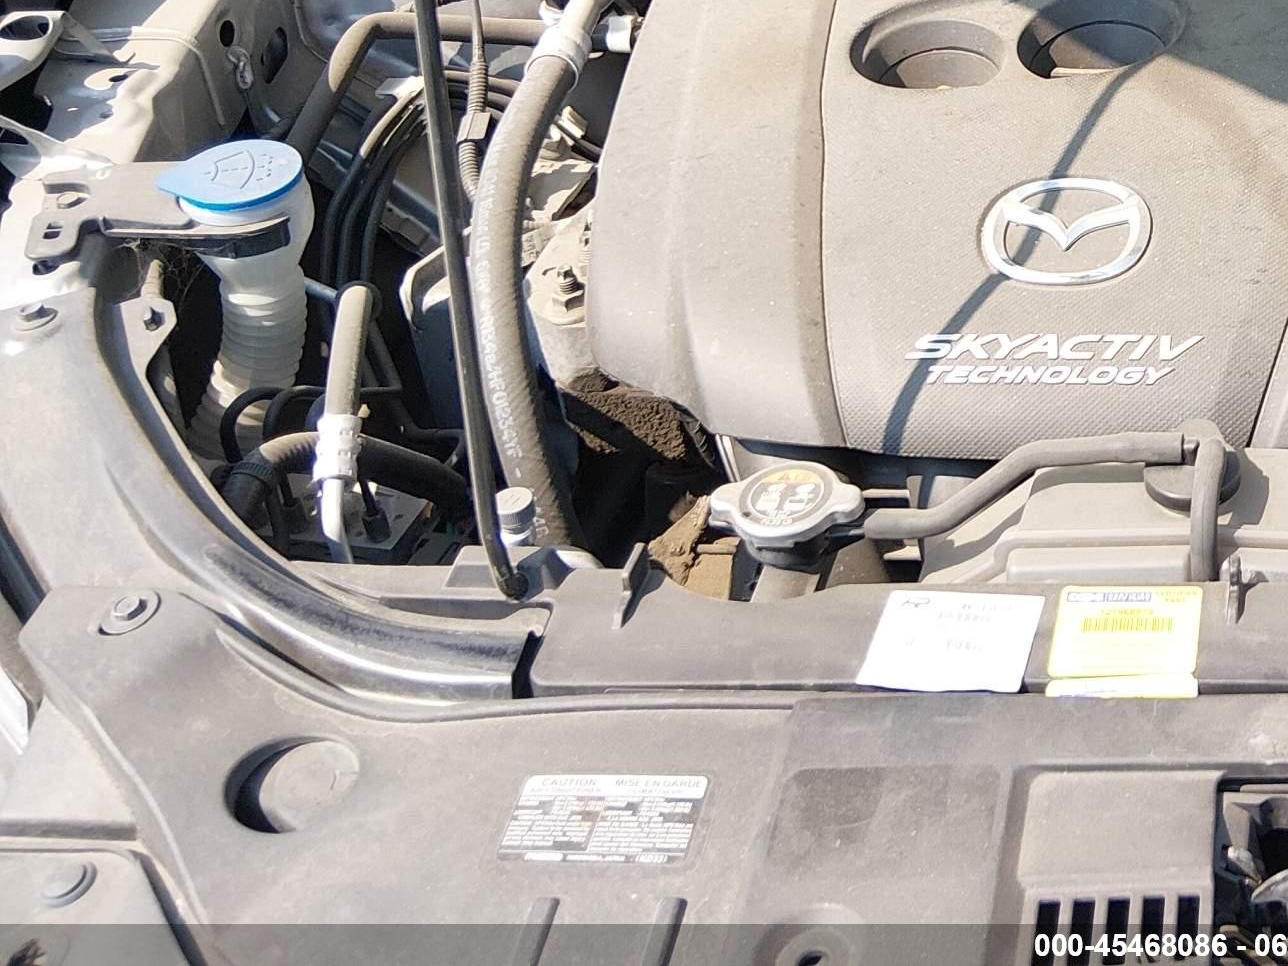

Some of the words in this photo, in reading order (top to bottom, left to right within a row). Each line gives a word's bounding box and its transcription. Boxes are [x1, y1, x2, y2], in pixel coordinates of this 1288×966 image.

[904, 333, 1205, 361] SKYACTIV
[926, 365, 1176, 385] TECHNOLOGY
[541, 778, 597, 786] CAUTION
[662, 779, 702, 788] GARDE
